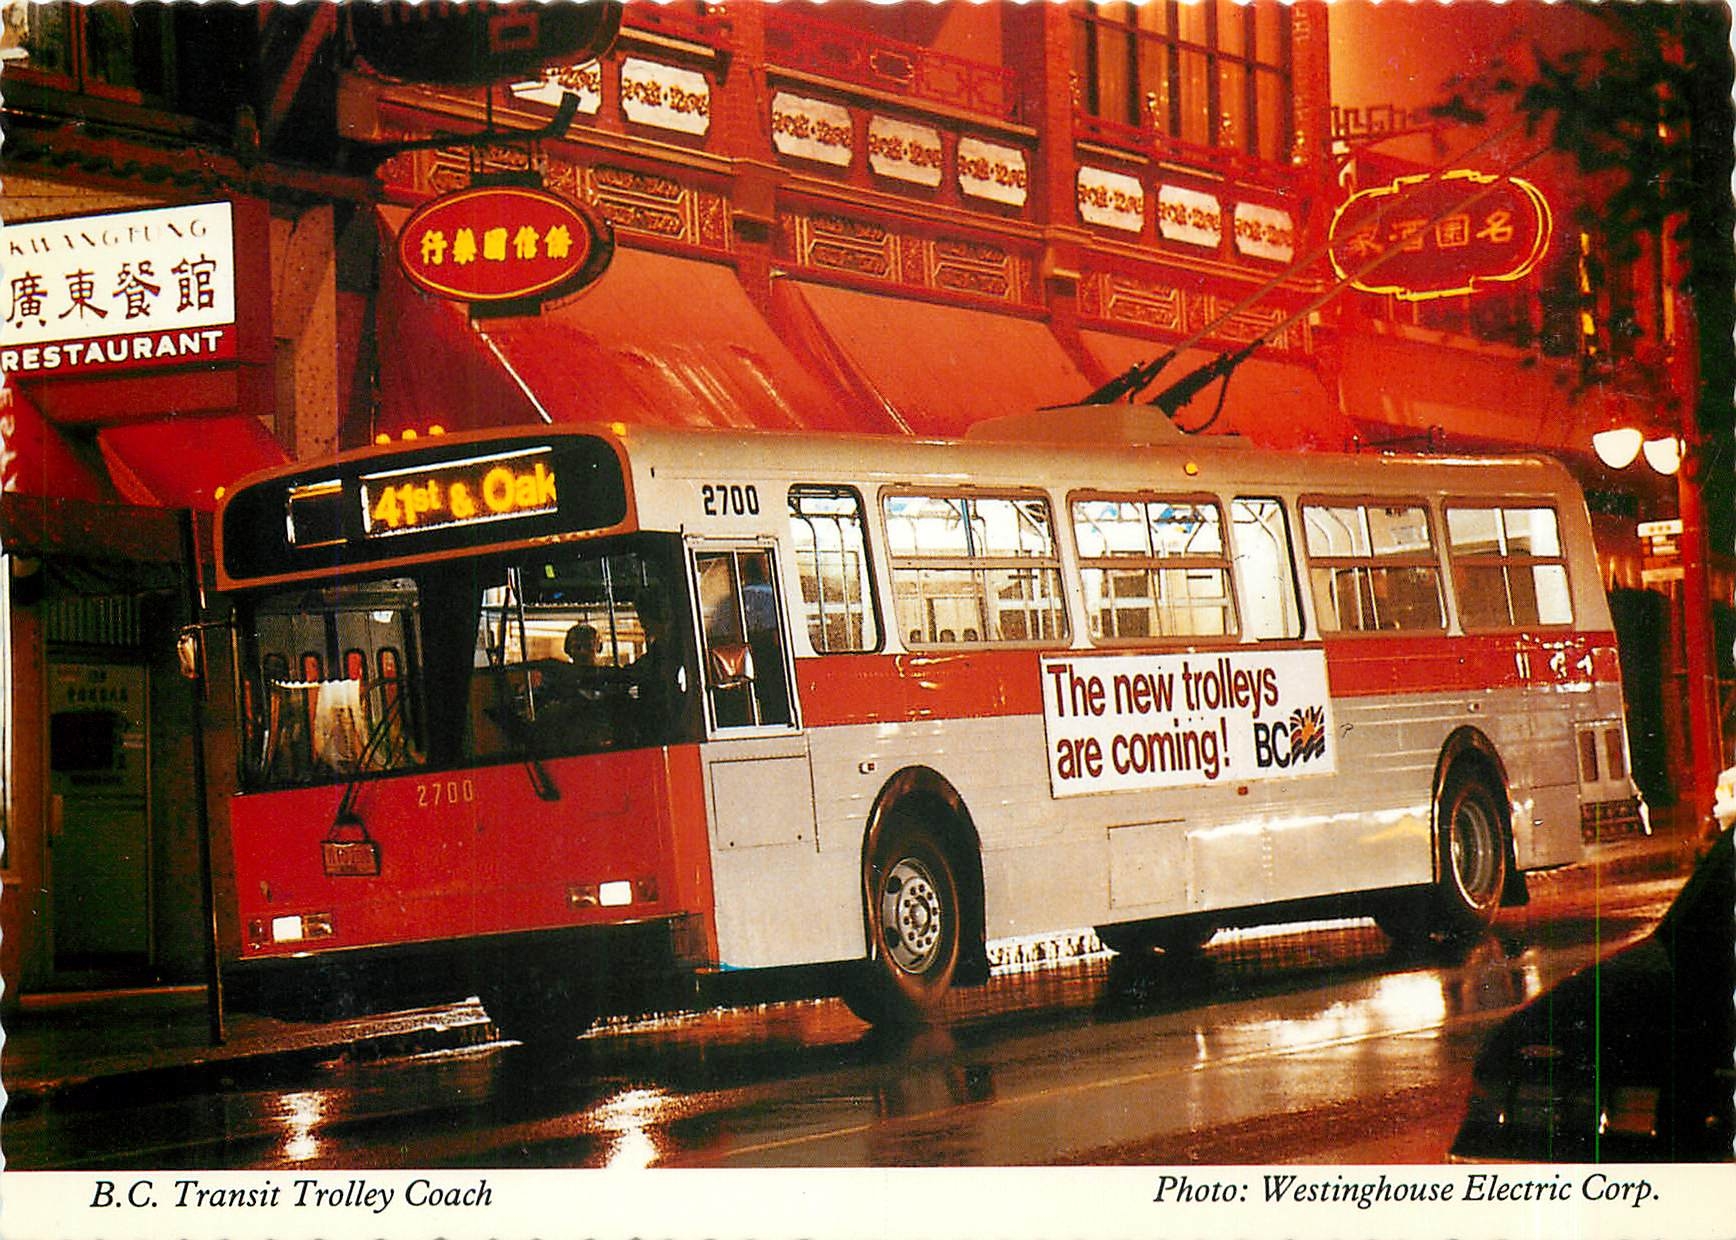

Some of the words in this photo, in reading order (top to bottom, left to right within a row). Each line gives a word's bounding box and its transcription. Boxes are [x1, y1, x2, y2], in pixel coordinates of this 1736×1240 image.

[6, 254, 217, 330] 廣東餐館
[1, 330, 223, 373] RESTAURANT
[373, 480, 441, 529] 41st
[449, 482, 476, 518] &
[483, 463, 557, 513] Oak
[702, 484, 760, 516] 2700
[1047, 663, 1106, 718] The
[1113, 672, 1175, 715] new
[1182, 658, 1280, 719] trolleys
[1057, 737, 1104, 780] are
[1112, 717, 1231, 780] coming!
[1253, 721, 1291, 769] BC
[417, 780, 474, 808] 2700
